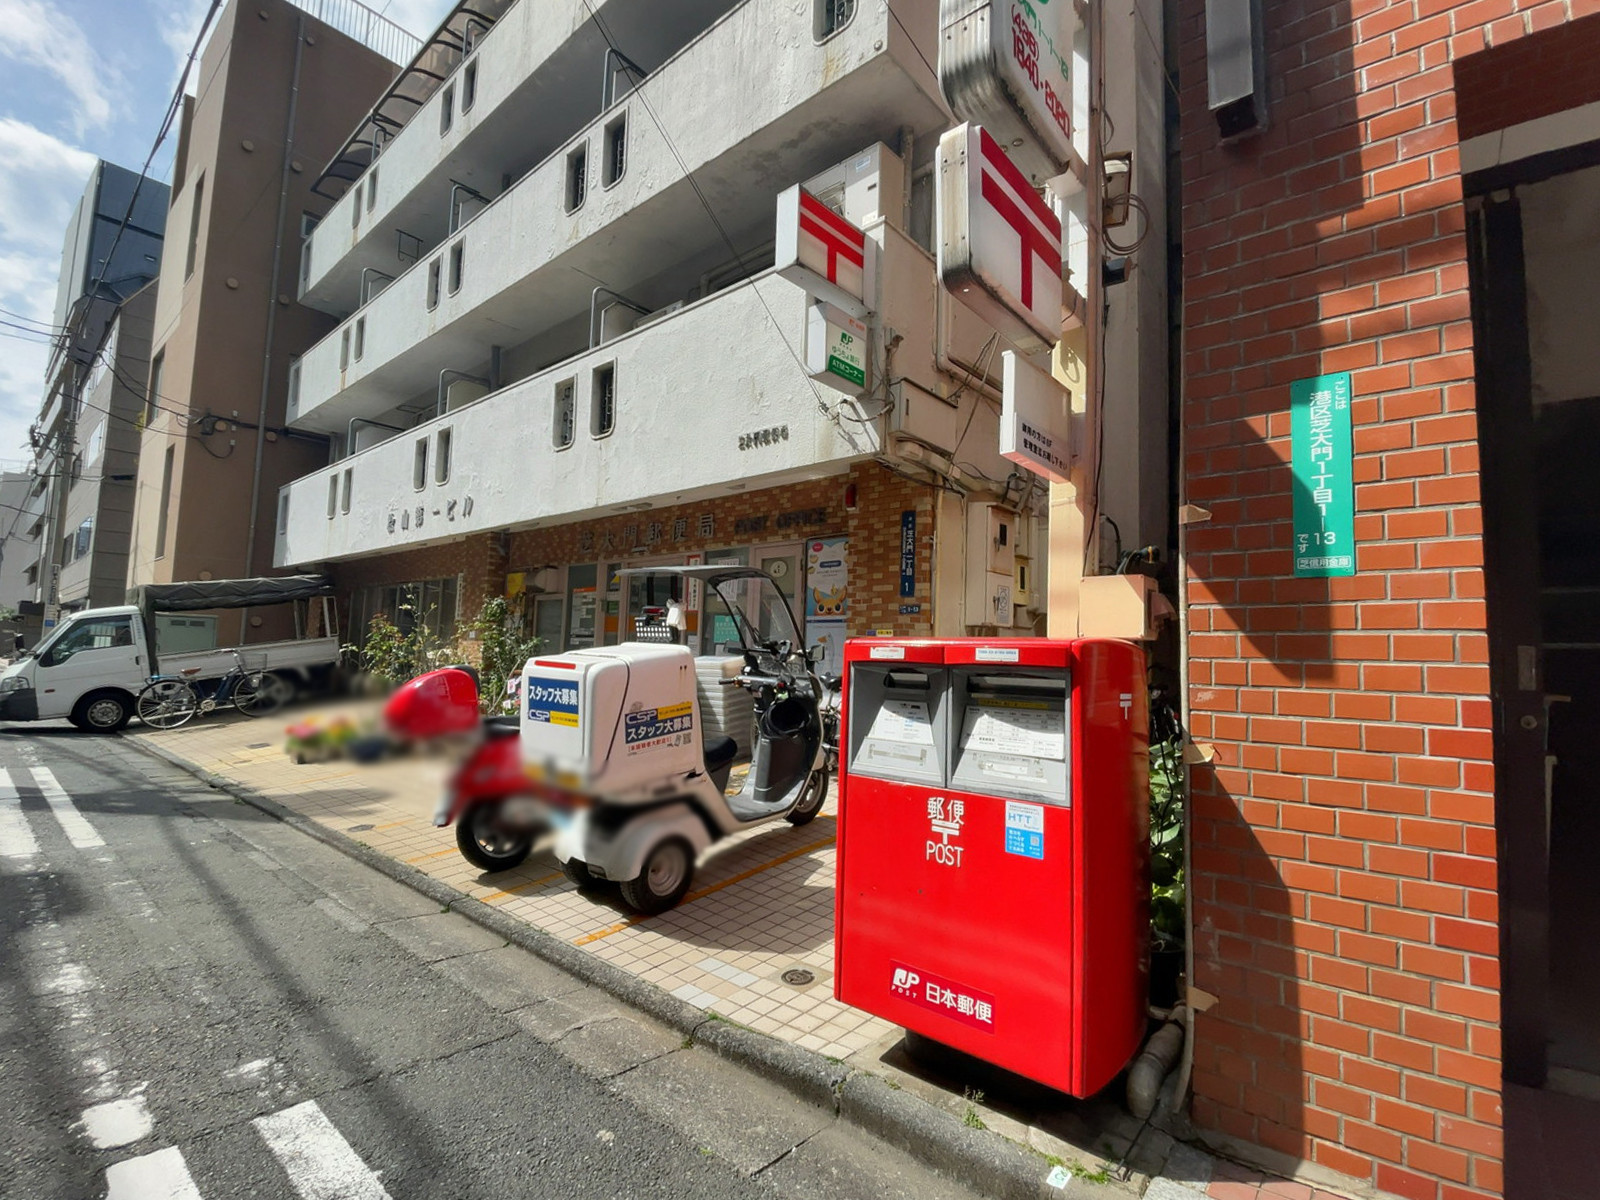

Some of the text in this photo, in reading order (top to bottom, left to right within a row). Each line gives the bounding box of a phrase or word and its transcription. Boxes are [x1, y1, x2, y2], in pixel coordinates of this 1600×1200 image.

[1334, 381, 1347, 410] ここは
[1297, 533, 1309, 554] です
[1299, 557, 1349, 568] 芝信用金庫
[528, 685, 579, 706] スタッフ大募集
[528, 709, 550, 721] CSP
[626, 711, 657, 725] CSP
[627, 716, 692, 741] スタッフ大募集
[927, 797, 965, 825] 郵便
[1007, 812, 1031, 824] HTT
[926, 840, 964, 867] POST
[892, 967, 920, 989] JP
[926, 982, 992, 1024] 日本郵便
